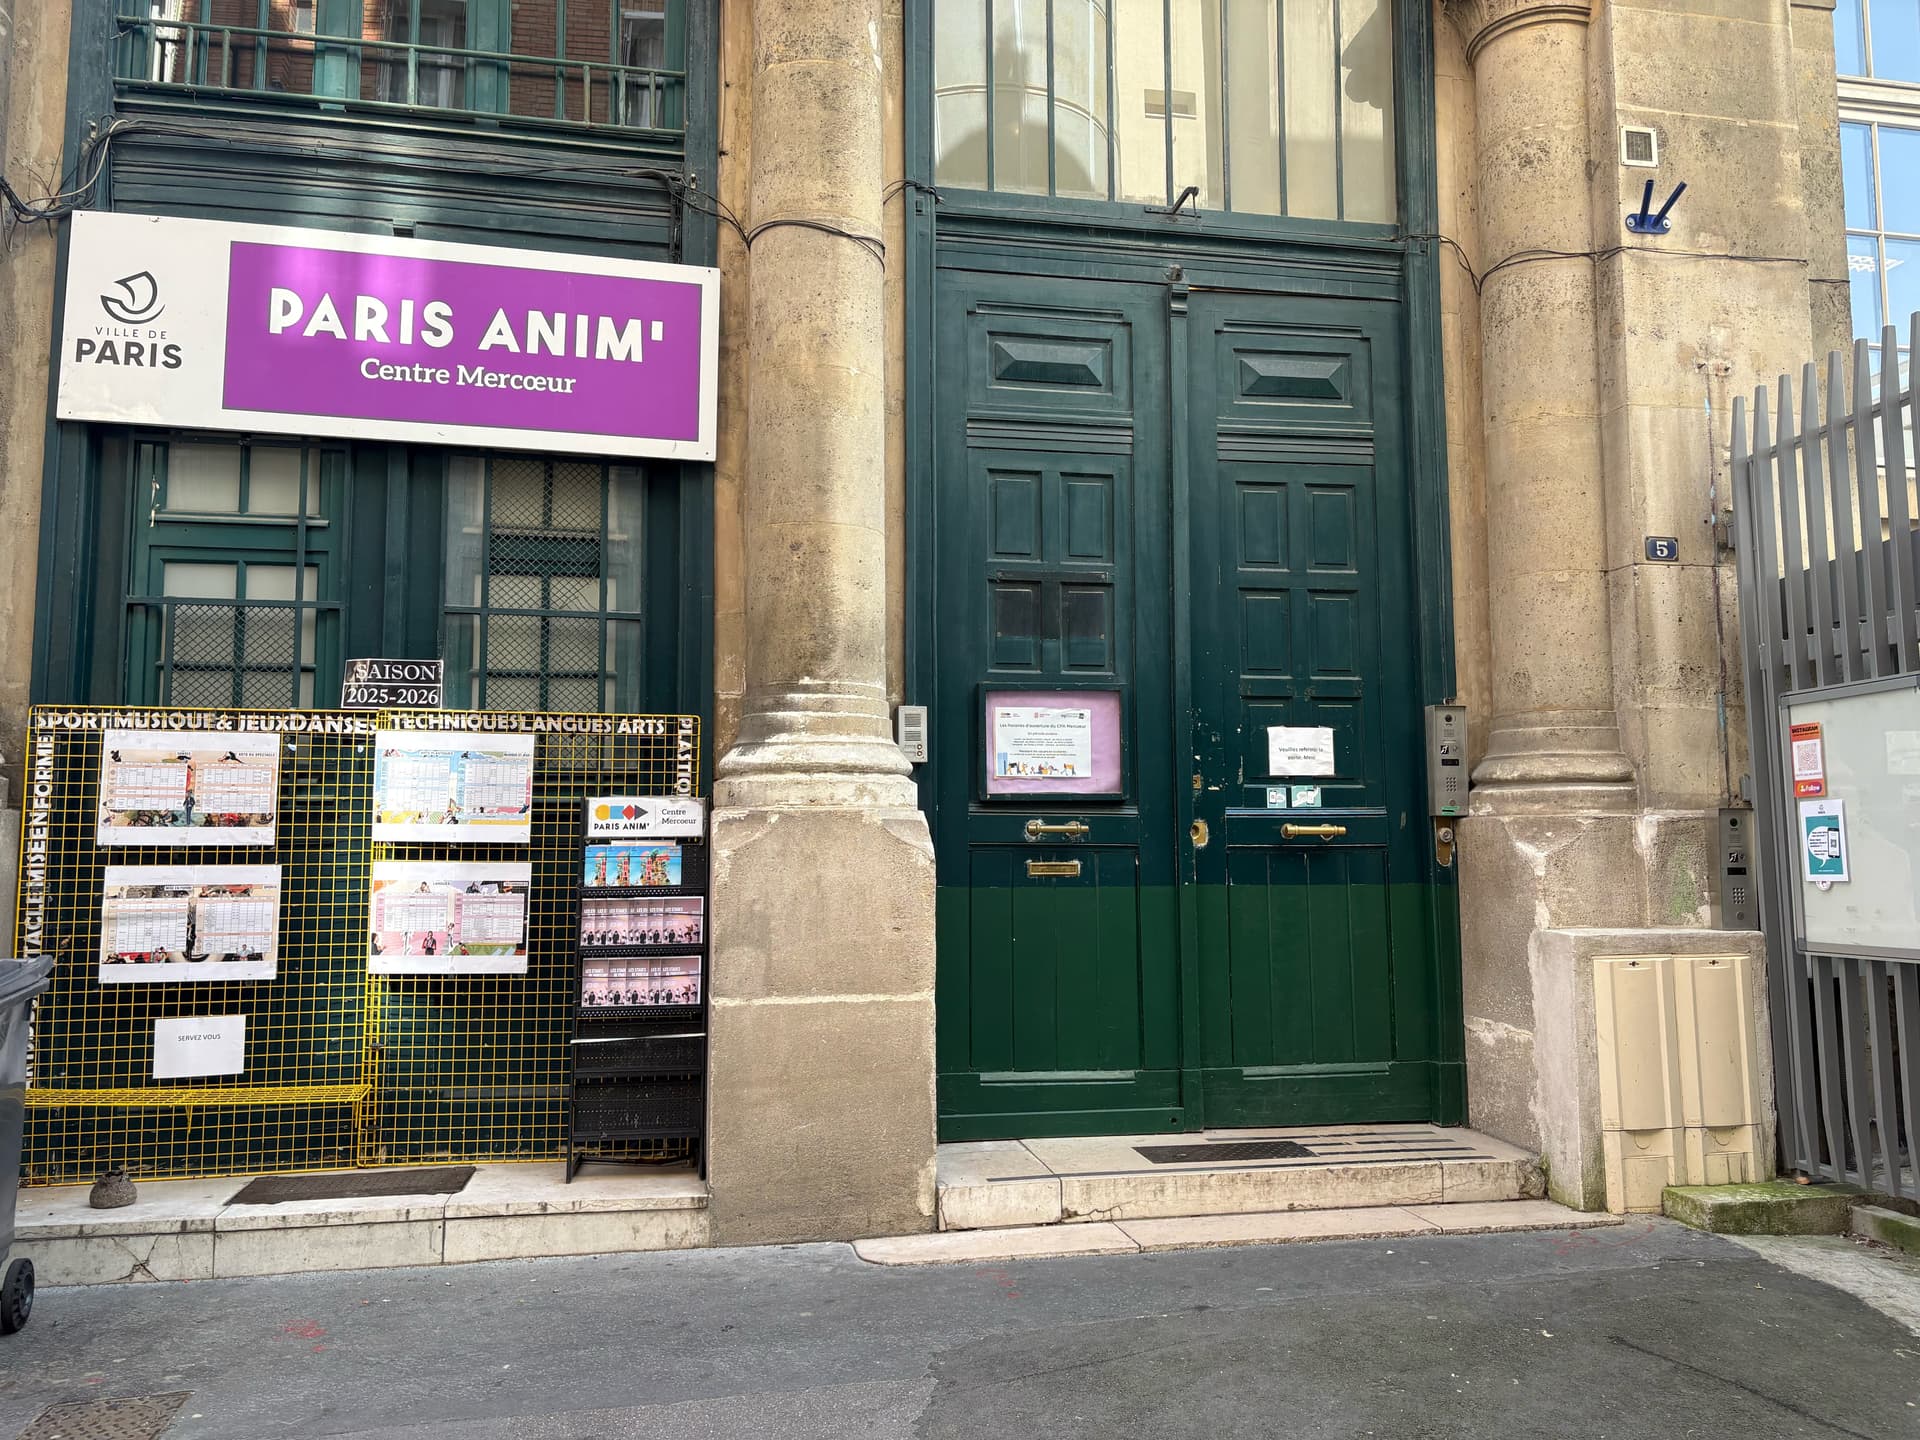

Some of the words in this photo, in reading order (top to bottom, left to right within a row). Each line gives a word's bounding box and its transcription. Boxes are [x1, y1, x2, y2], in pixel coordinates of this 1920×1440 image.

[95, 327, 138, 338] VILLE
[148, 330, 167, 340] DE
[268, 287, 456, 348] PARIS
[478, 307, 664, 363] ANIM'
[75, 338, 182, 368] PARIS
[361, 358, 450, 386] Centre
[456, 364, 577, 394] Mercœur
[1656, 541, 1668, 557] 5
[355, 662, 438, 682] SAISON
[346, 683, 440, 707] 2025-2026
[37, 712, 110, 728] SPORT
[113, 711, 215, 730] MUSIQUE
[216, 714, 232, 730] &
[238, 714, 290, 731] JEUX
[391, 713, 519, 731] TECHNIQUES
[520, 714, 612, 733] LANGUES
[617, 718, 665, 735] ARTS
[1791, 725, 1818, 734] INSTAGRAM
[661, 808, 686, 816] Centre
[661, 817, 697, 825] Mercoeur
